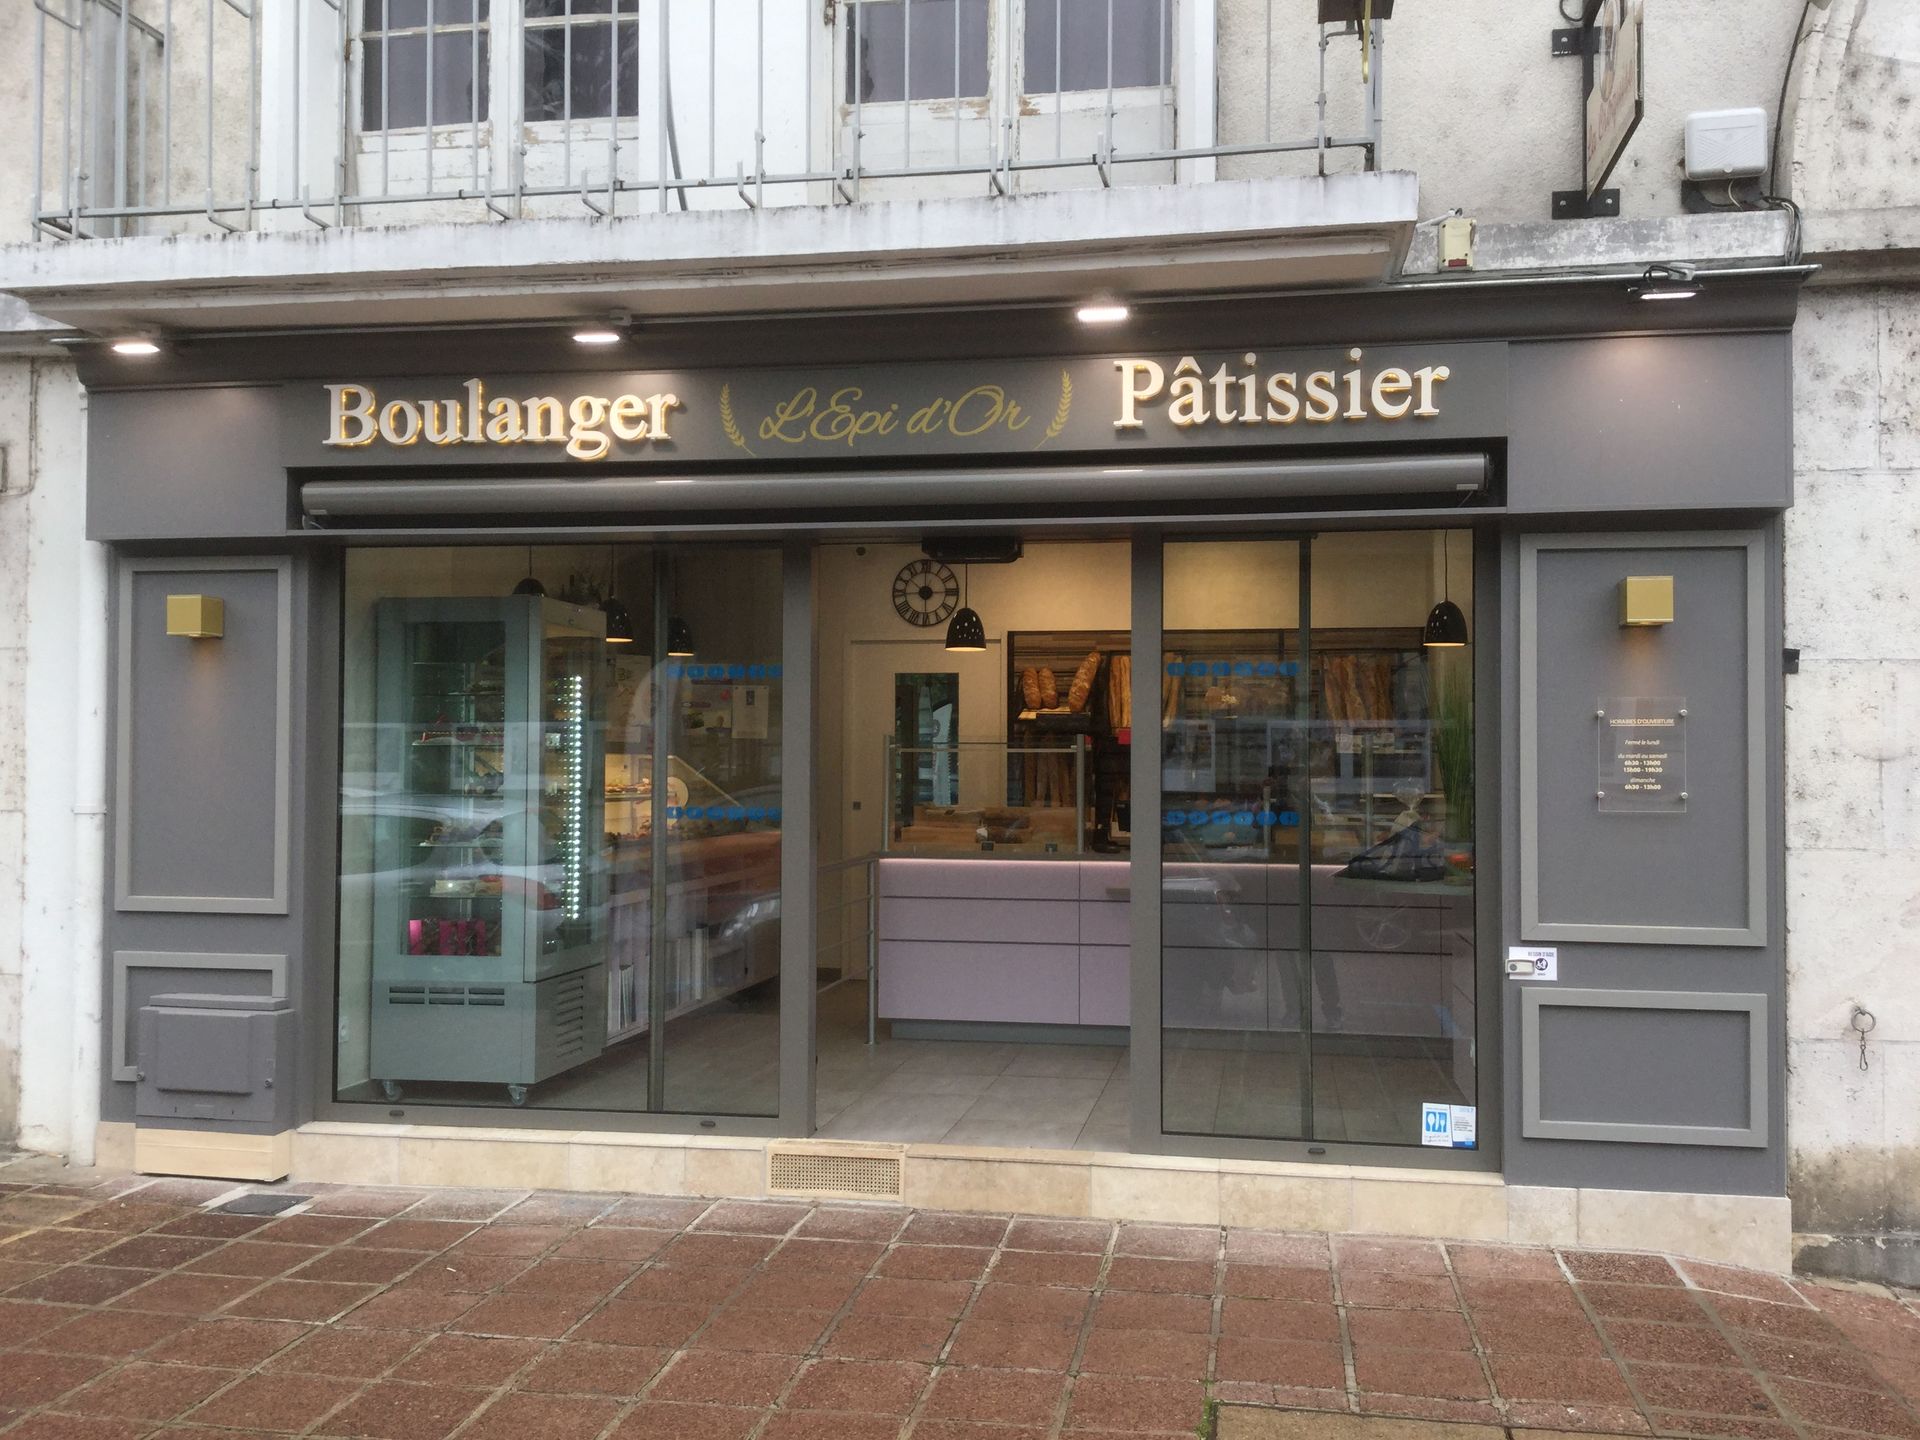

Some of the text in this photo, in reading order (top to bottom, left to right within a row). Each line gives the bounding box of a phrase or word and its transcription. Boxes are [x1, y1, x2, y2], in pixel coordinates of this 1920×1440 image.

[323, 378, 681, 460] Boulanger
[759, 384, 1031, 446] L'Epi d'Or
[1113, 347, 1450, 428] Pâtissier
